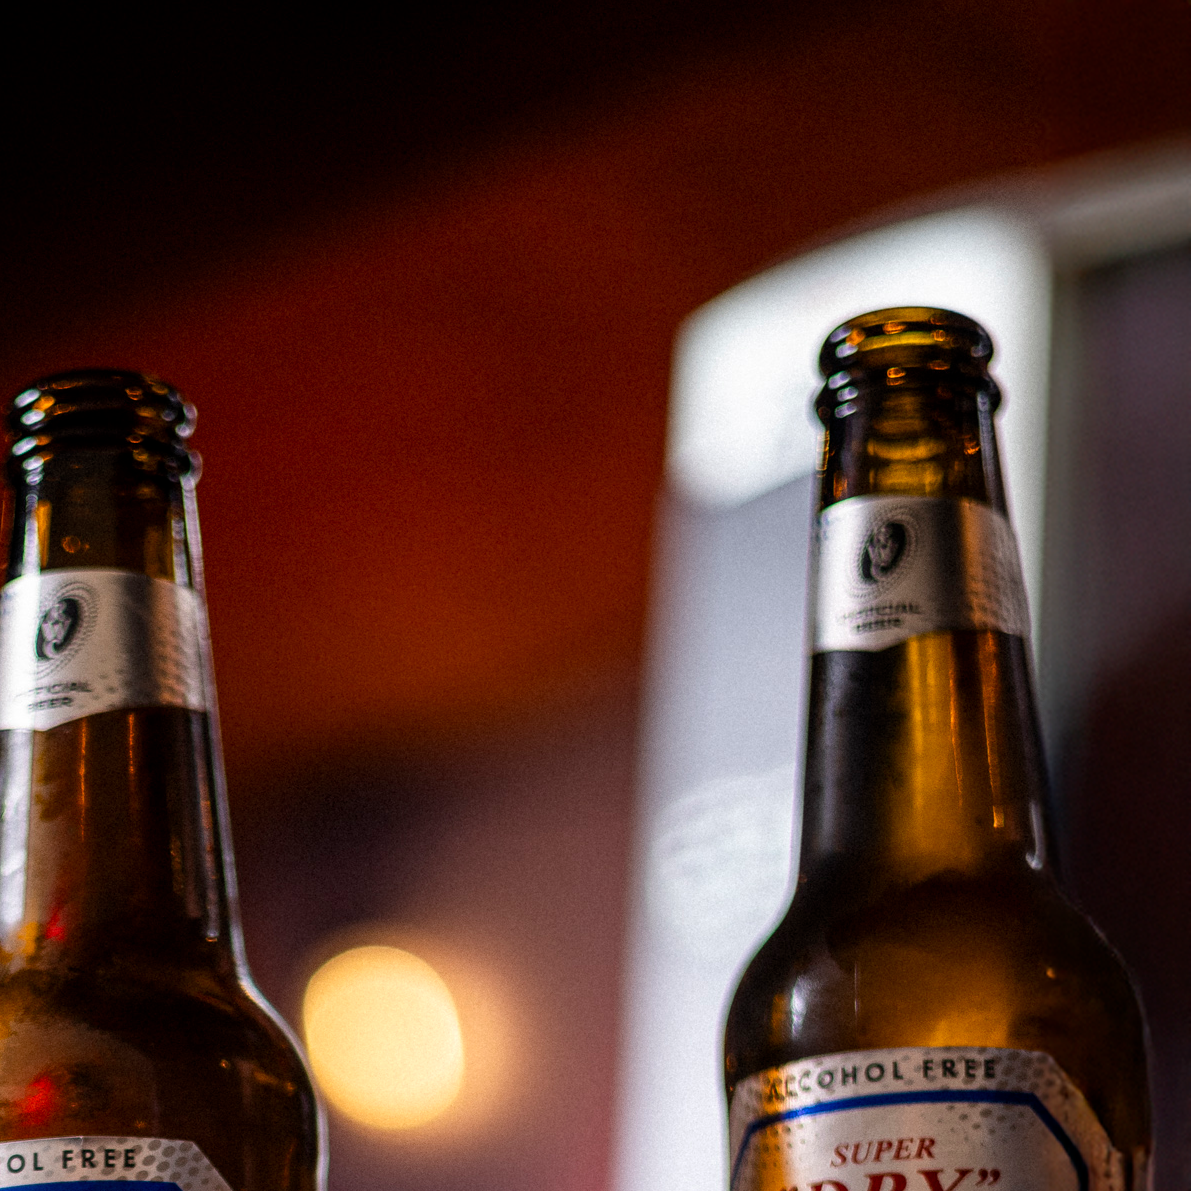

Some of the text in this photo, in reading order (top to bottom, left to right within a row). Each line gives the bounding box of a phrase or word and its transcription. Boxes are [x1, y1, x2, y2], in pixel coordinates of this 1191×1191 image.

[764, 1058, 996, 1101] ALCOHOL FREE
[62, 1148, 137, 1170] FREE
[830, 1136, 936, 1168] SUPER
